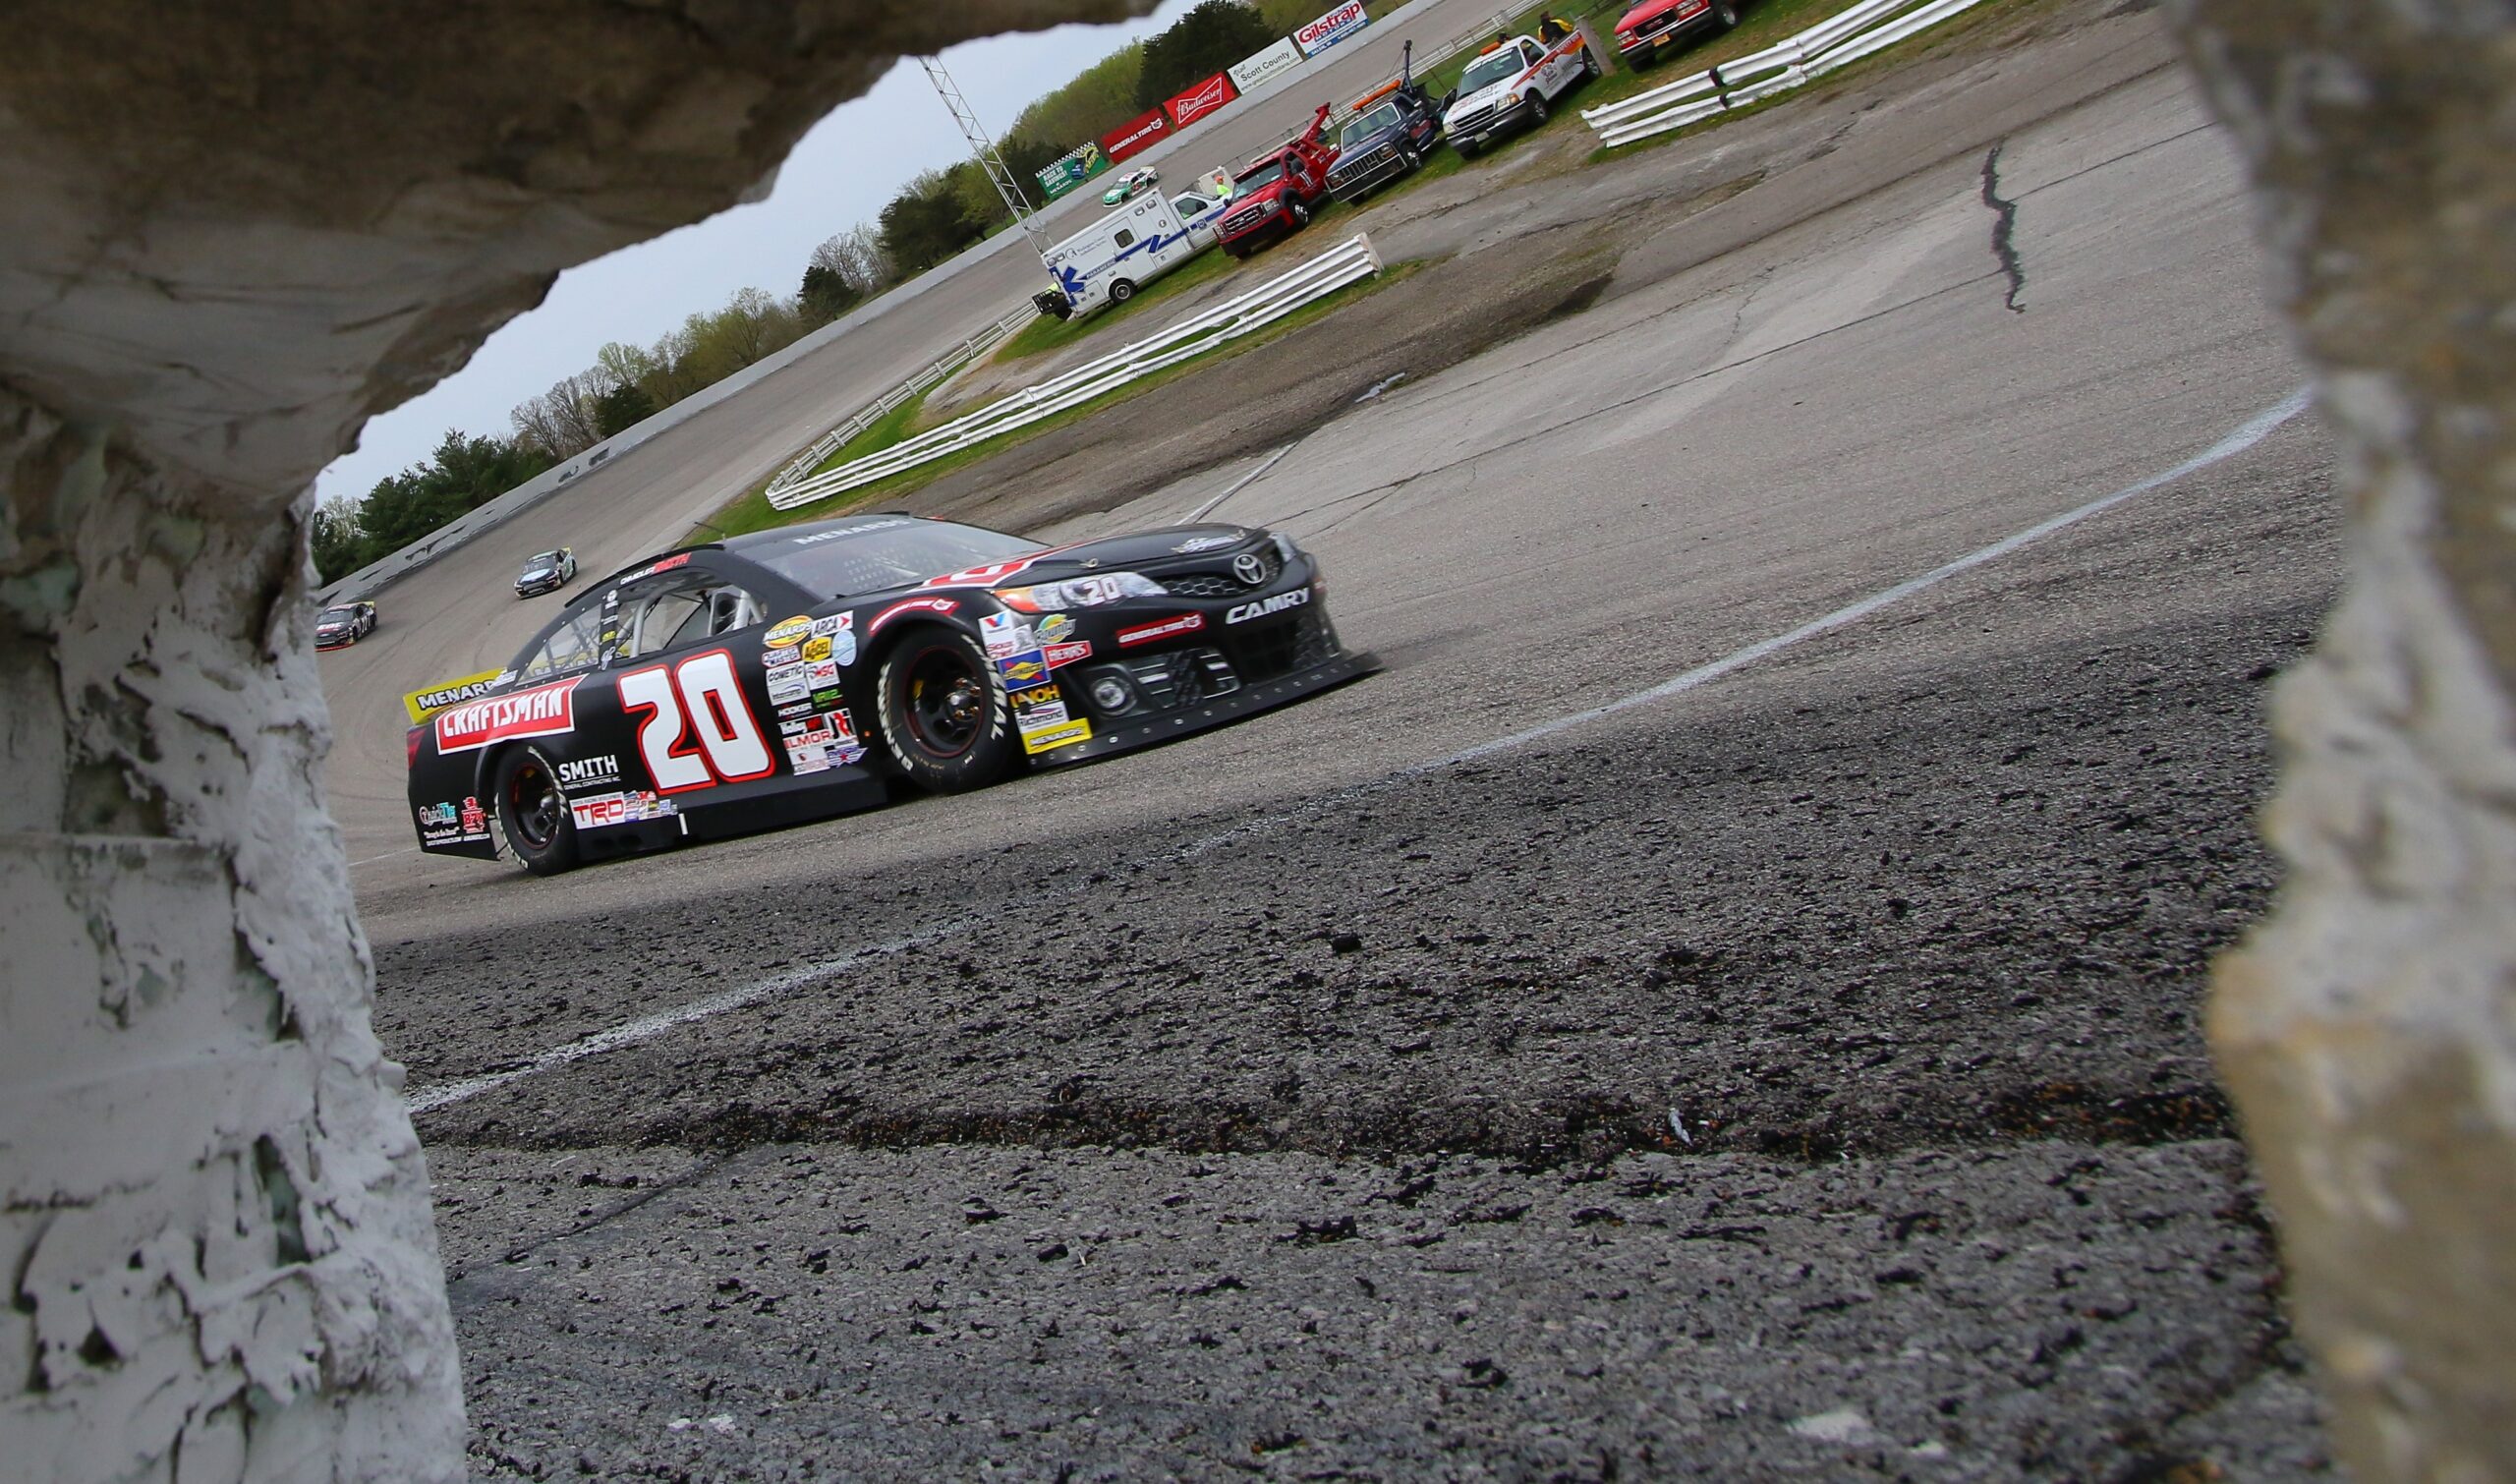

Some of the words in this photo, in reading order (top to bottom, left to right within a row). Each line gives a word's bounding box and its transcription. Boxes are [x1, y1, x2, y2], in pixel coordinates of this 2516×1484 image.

[1298, 3, 1360, 43] Gilstrap
[1239, 66, 1263, 83] Scott
[1261, 50, 1290, 71] County
[1180, 87, 1222, 116] Budweiser
[1109, 131, 1138, 154] GENERAL
[1135, 125, 1154, 140] TIRE
[1043, 169, 1058, 181] RACE
[792, 520, 911, 545] MENARDS
[1081, 575, 1121, 606] 20
[1225, 587, 1310, 626] CAMRY
[763, 620, 814, 645] MENARDS
[813, 615, 838, 638] ARCA
[768, 665, 803, 682] COMETIC
[416, 678, 495, 711] MENARD
[443, 687, 567, 738] CRAFTSMAN
[618, 652, 772, 792] 20
[1018, 710, 1064, 726] Richmond
[783, 730, 831, 748] ILMOR
[1029, 727, 1085, 745] MENARDS
[558, 754, 619, 782] SMITH
[572, 799, 624, 826] TRD
